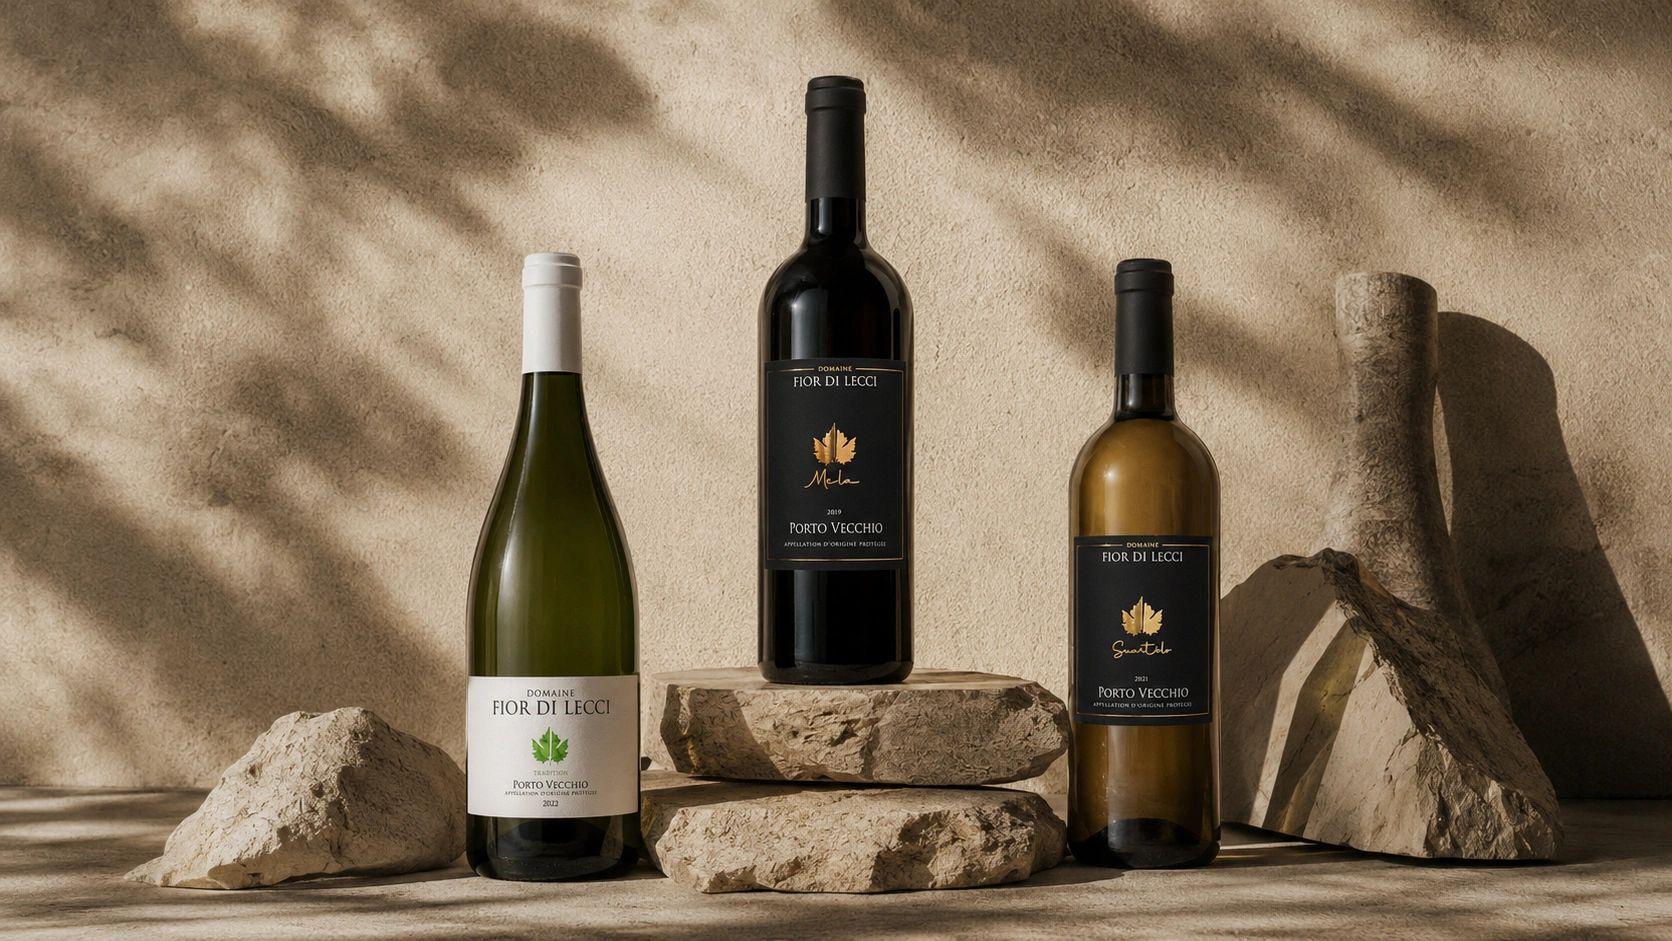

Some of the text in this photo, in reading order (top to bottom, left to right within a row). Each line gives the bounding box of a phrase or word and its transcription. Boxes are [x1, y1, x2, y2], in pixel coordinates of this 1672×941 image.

[793, 375, 877, 388] FIOR DI LECCI
[804, 468, 860, 490] Mela
[789, 522, 883, 534] PORTO VECCHIO
[1102, 551, 1183, 562] FIOR DI LECCI
[527, 689, 575, 697] DOMAINE
[1098, 686, 1189, 699] PORTO VECCHIO
[493, 699, 610, 715] FIOR DI LECCI
[513, 780, 589, 789] PORTO VECCHIO
